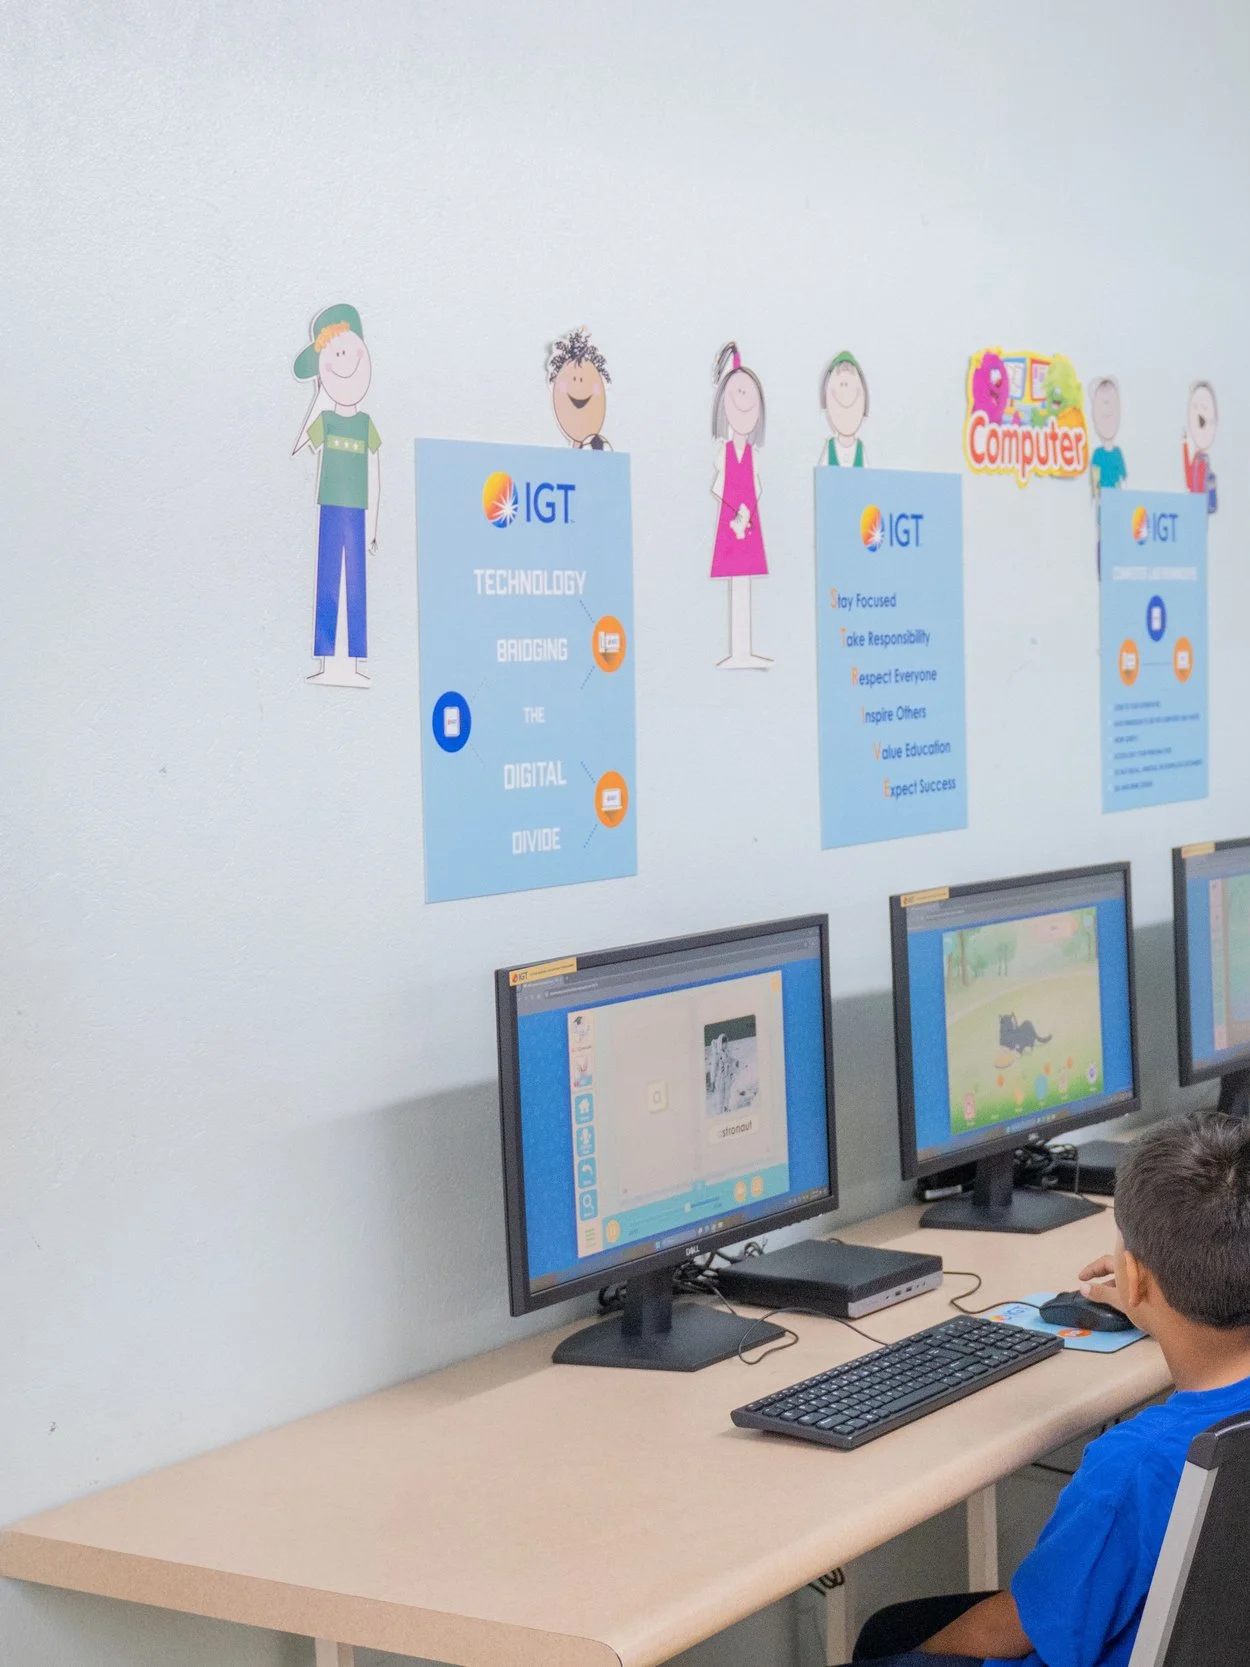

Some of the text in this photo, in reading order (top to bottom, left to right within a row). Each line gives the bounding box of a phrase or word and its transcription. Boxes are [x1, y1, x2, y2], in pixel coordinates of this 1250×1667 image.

[969, 414, 1084, 479] Computer
[525, 481, 577, 525] IGT
[888, 512, 925, 548] IGT
[1152, 511, 1179, 543] IGT
[473, 568, 588, 596] TECHNOLOGY
[830, 587, 898, 612] Stay Focused
[496, 637, 569, 663] BRIDGING
[840, 626, 931, 649] Take Responsibility
[851, 666, 938, 688] Respect Everyone
[523, 706, 546, 724] THE
[861, 704, 927, 726] Inspire Others
[873, 739, 951, 761] Value Education
[503, 760, 567, 790] DIGITAL
[883, 777, 957, 800] Expect Success
[511, 827, 562, 855] DIVIDE
